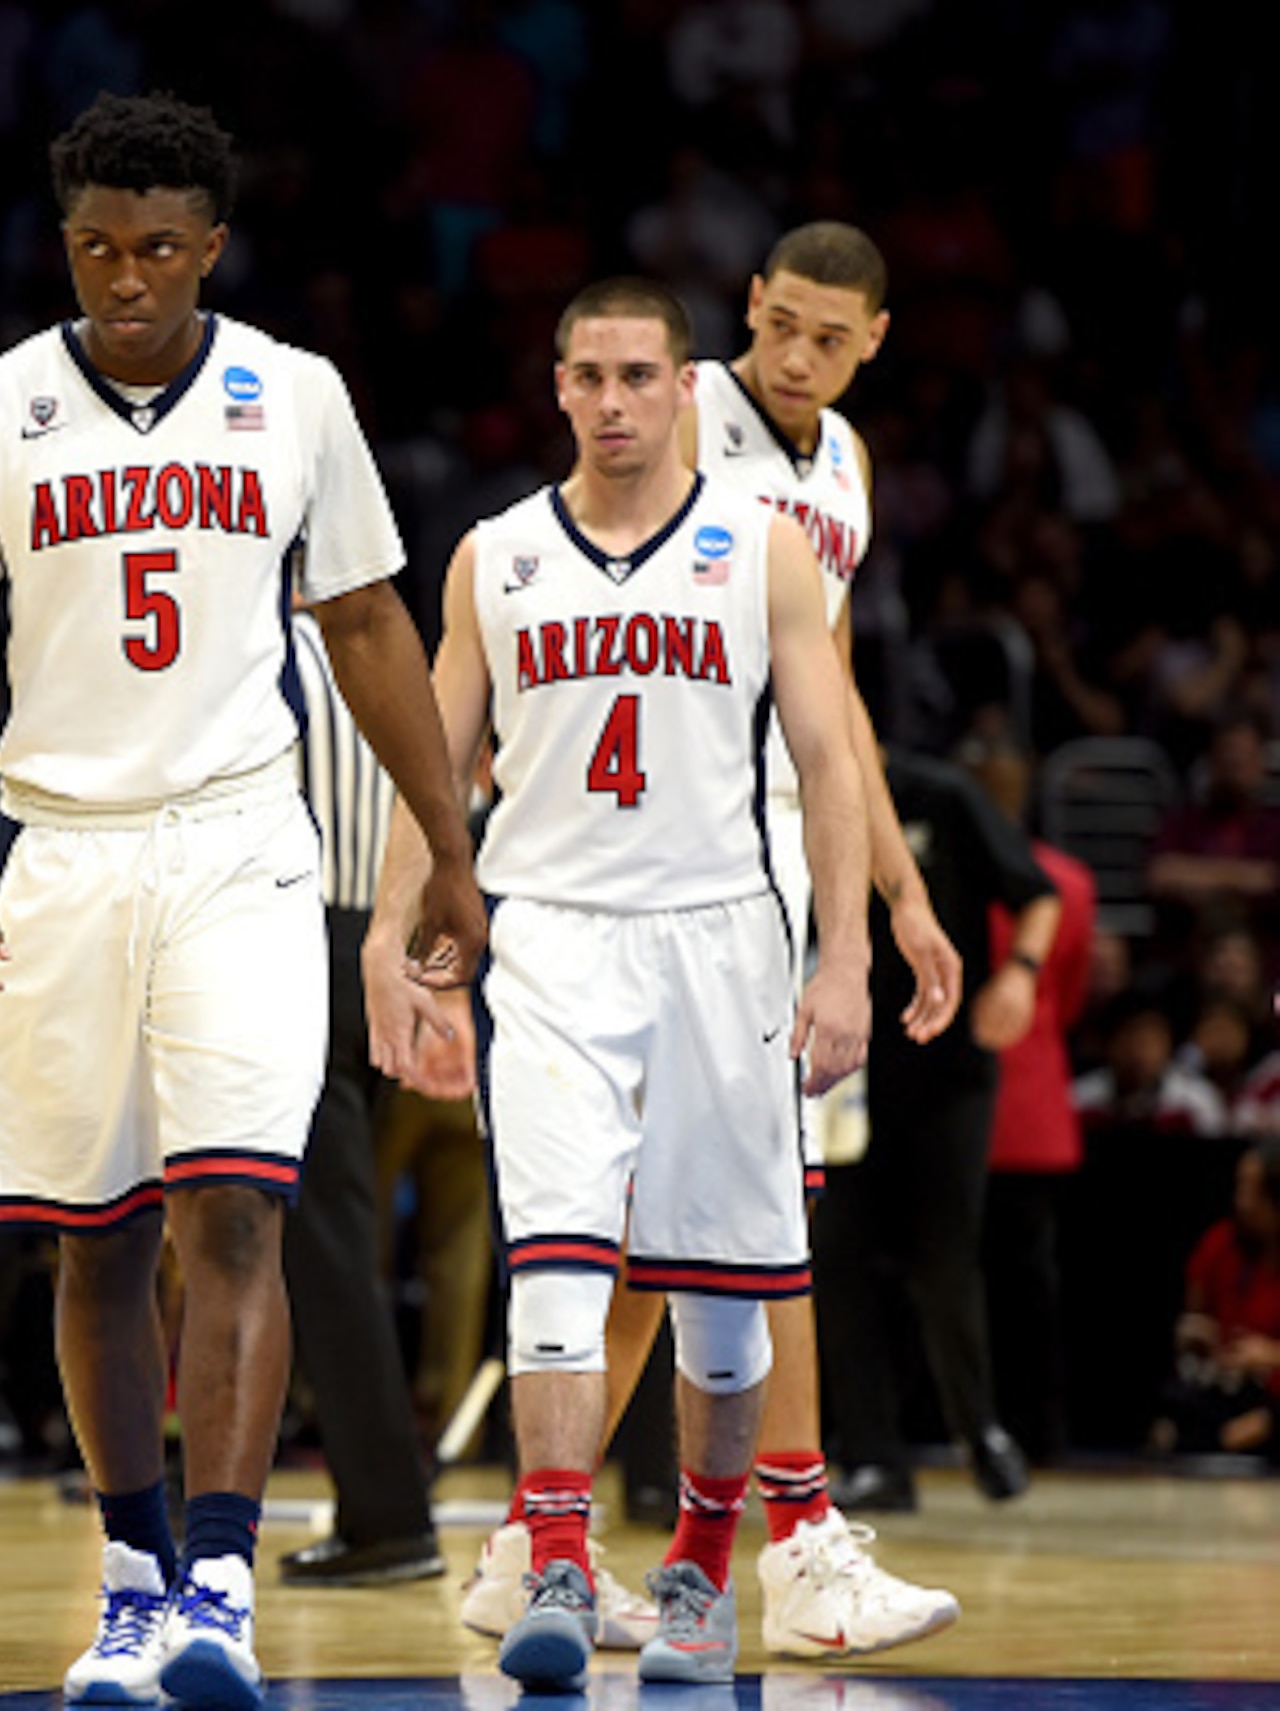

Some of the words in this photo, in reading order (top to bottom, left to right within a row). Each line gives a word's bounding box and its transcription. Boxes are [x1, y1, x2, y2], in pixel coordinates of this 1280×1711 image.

[31, 462, 269, 551] ARIZONA
[122, 549, 180, 672] 5
[517, 612, 731, 692] ARIZONA
[587, 694, 646, 808] 4
